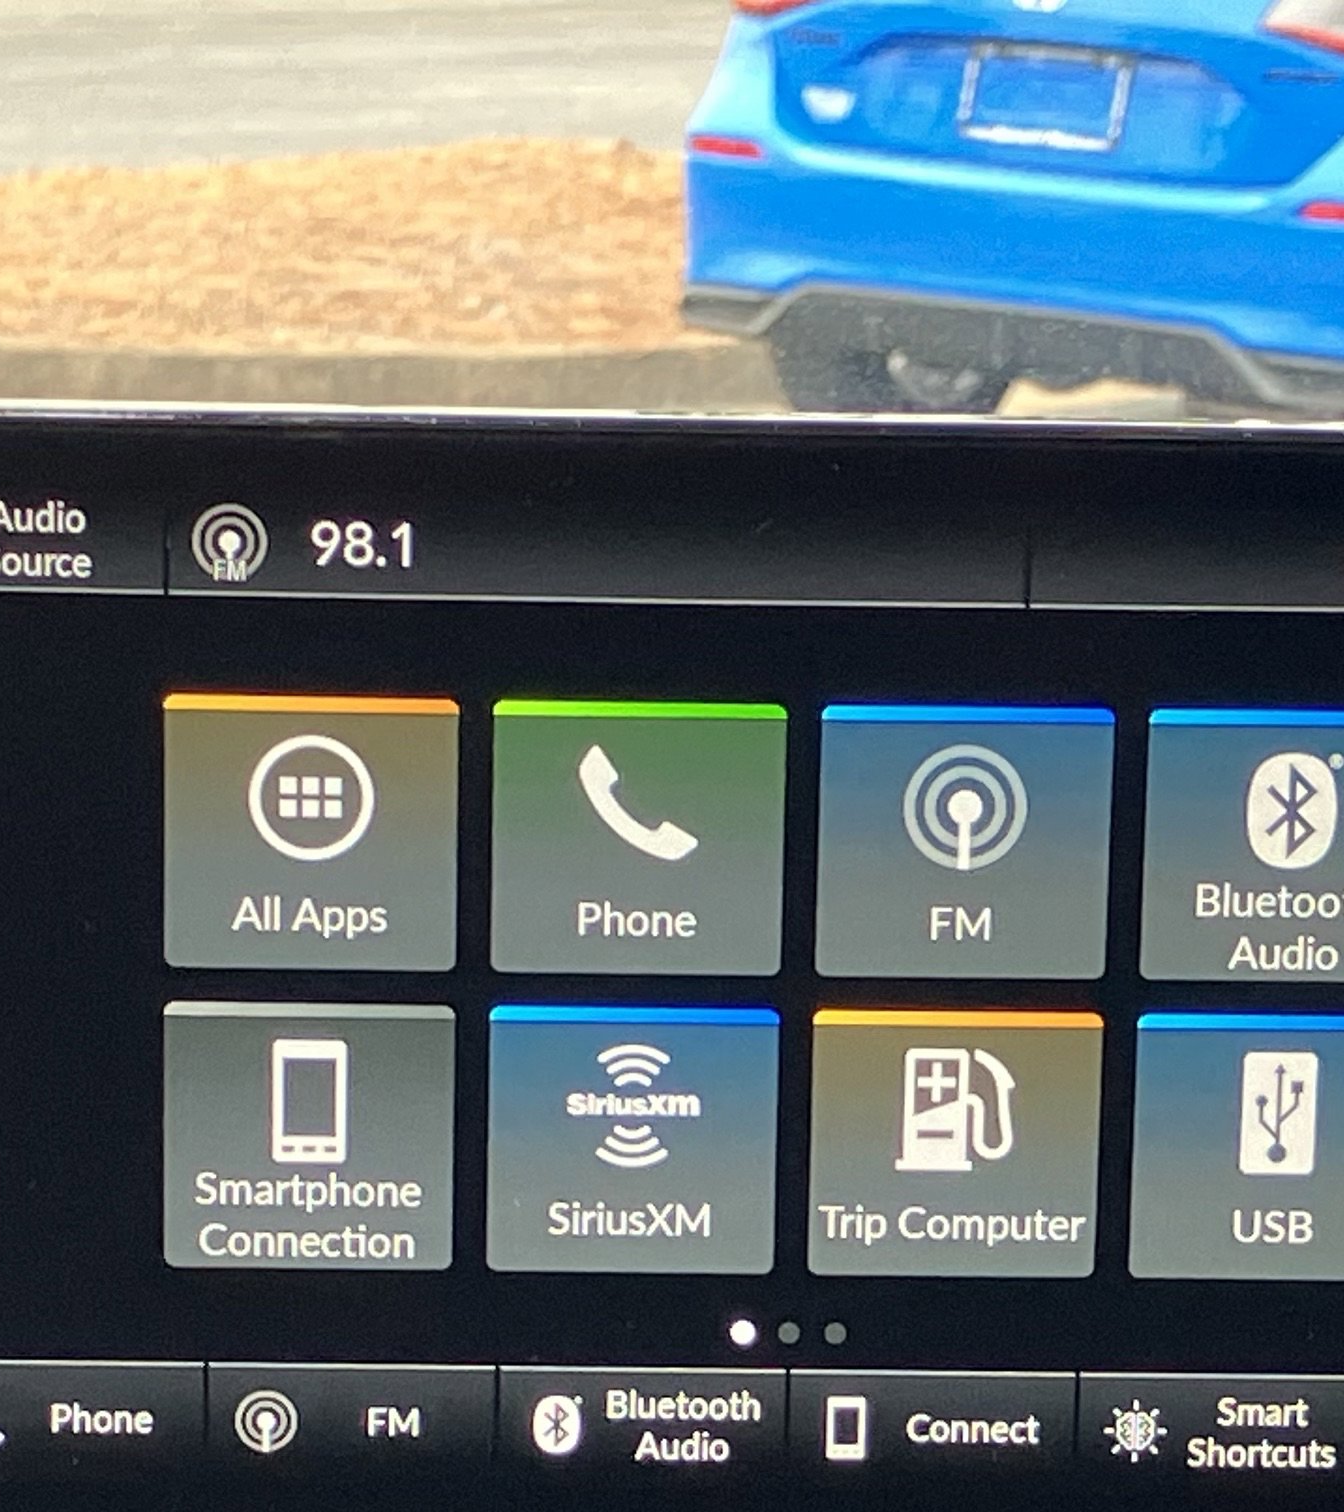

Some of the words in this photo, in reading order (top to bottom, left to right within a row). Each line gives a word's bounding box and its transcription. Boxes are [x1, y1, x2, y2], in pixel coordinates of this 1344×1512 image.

[308, 517, 416, 570] 98.1
[229, 894, 282, 935] All
[290, 896, 389, 940] Apps
[574, 899, 698, 938] Phone
[926, 904, 994, 942] FM
[1226, 934, 1340, 972] Audio
[192, 1170, 424, 1212] Smartphone
[545, 1200, 713, 1239] SiriusXM
[816, 1202, 889, 1247] Trip
[896, 1203, 1088, 1246] Computer
[1230, 1209, 1315, 1246] USB
[196, 1220, 416, 1260] Connection
[48, 1401, 156, 1437] Phone
[364, 1404, 422, 1439] FM
[602, 1388, 764, 1423] Bluetooth
[1214, 1396, 1310, 1429] Smart
[632, 1430, 733, 1464] Audio
[903, 1412, 1042, 1447] Connect
[1184, 1437, 1338, 1471] Shortcuts
